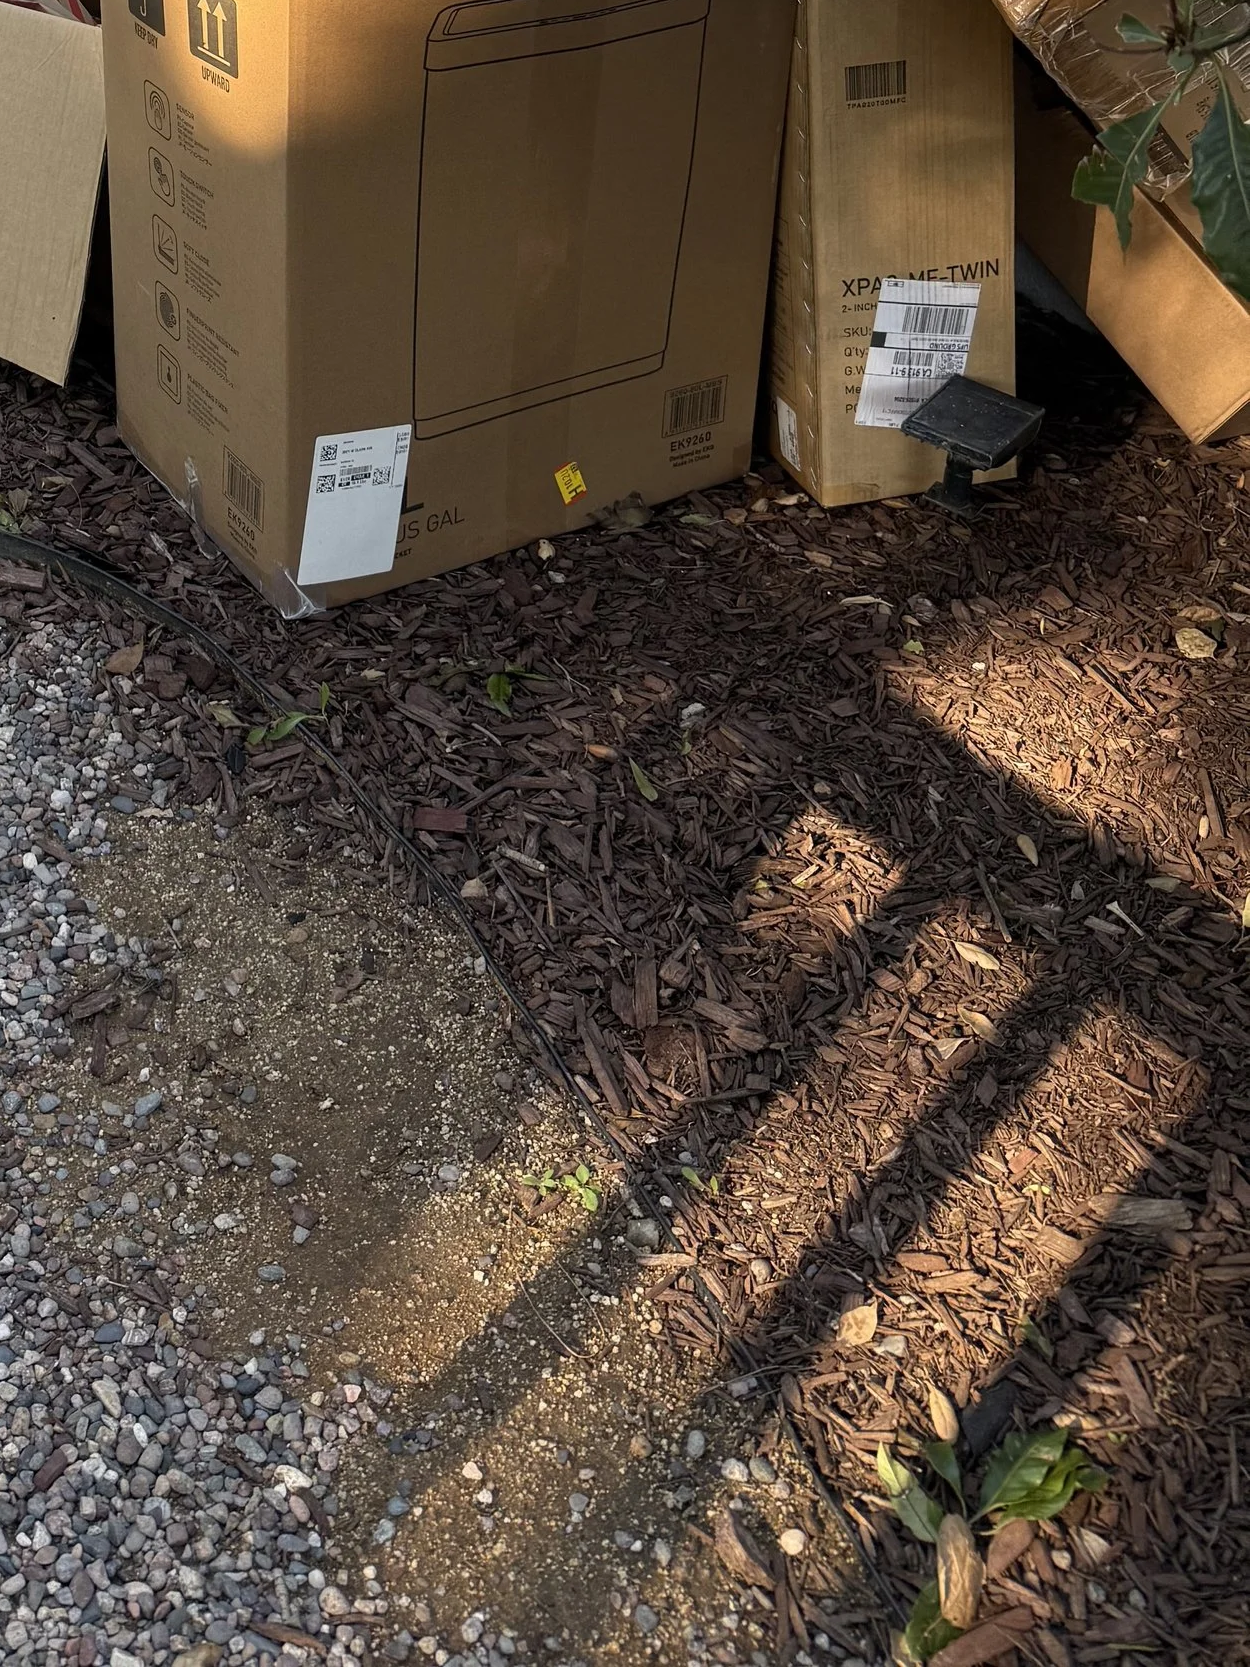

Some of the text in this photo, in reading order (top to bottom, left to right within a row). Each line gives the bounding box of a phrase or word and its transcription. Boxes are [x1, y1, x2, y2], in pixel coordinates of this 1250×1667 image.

[134, 21, 158, 50] KEEP DRY
[201, 65, 230, 93] UPWARD
[176, 102, 195, 120] SENSOR
[854, 303, 877, 312] INCH
[844, 326, 872, 338] SKU:
[957, 342, 969, 350] UPS
[922, 368, 932, 377] CA
[845, 386, 861, 395] Me
[670, 431, 712, 452] EK9260
[228, 507, 255, 541] EK9260
[426, 506, 465, 532] GAL
